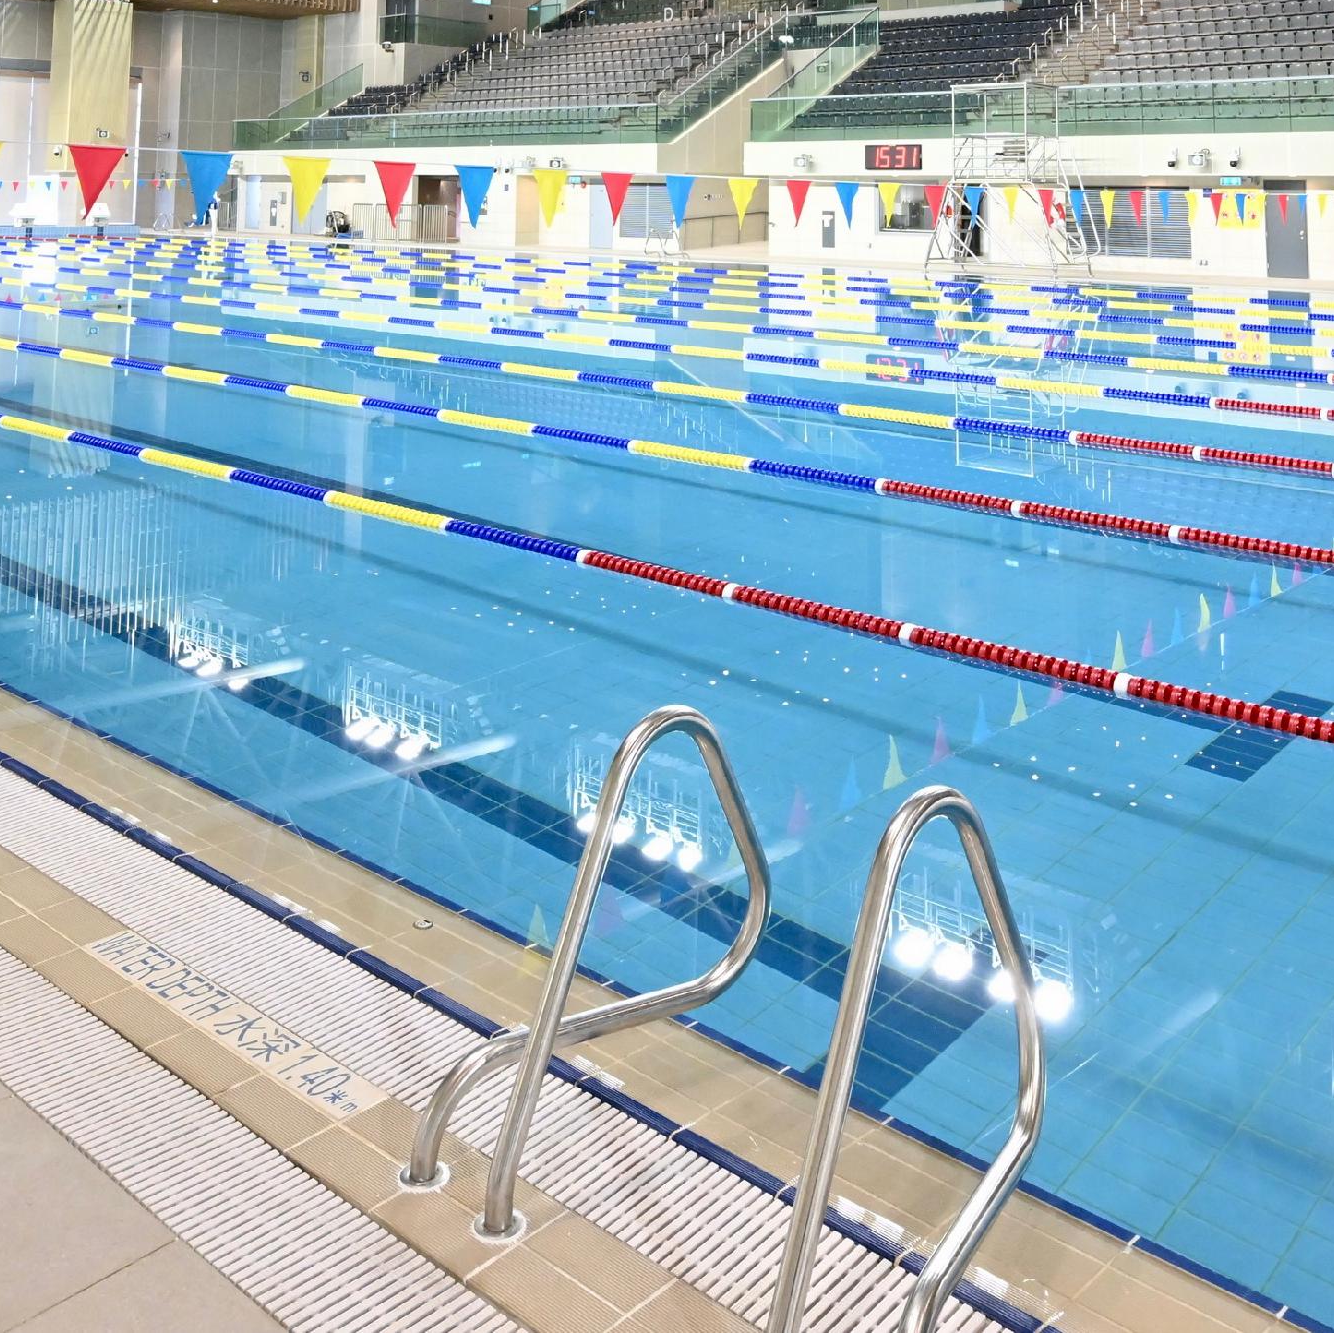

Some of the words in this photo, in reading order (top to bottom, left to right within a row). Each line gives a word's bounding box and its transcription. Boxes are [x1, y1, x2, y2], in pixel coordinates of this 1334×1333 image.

[663, 7, 674, 22] D
[91, 931, 176, 981] WATER
[145, 967, 240, 1021] DEPTH
[213, 1014, 302, 1063] 水深
